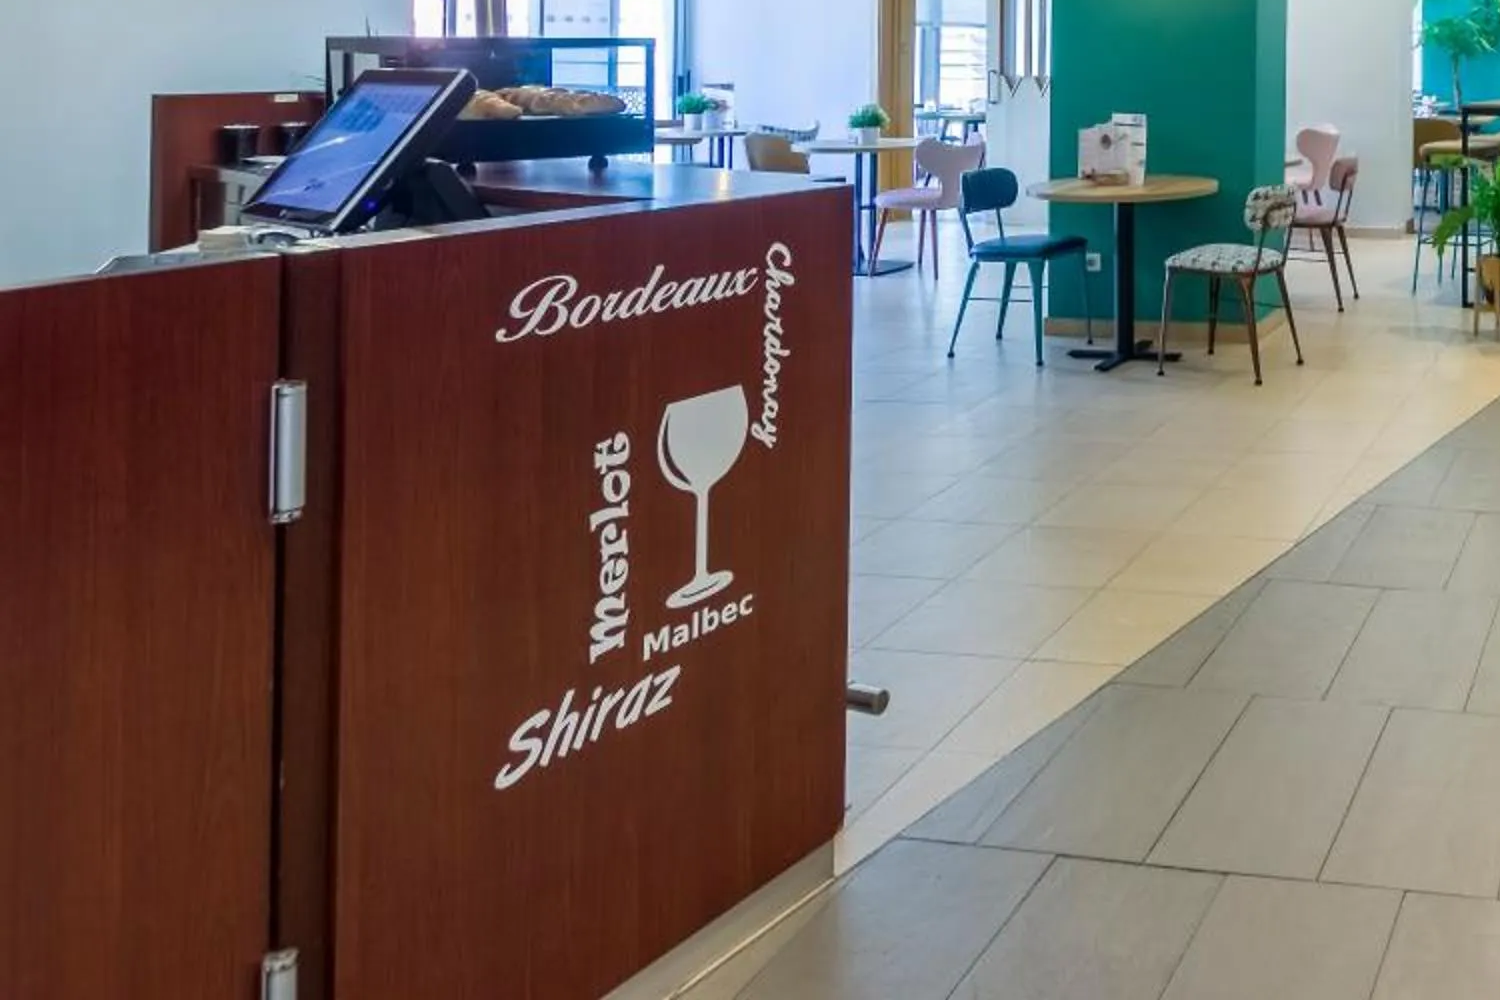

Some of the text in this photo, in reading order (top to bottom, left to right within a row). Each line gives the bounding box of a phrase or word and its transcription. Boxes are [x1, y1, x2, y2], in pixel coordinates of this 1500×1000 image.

[495, 264, 760, 343] Bordeaux
[750, 241, 796, 449] Chardonay
[589, 431, 631, 664] Merlot
[643, 593, 754, 661] Malbec
[494, 664, 682, 791] Shiraz
